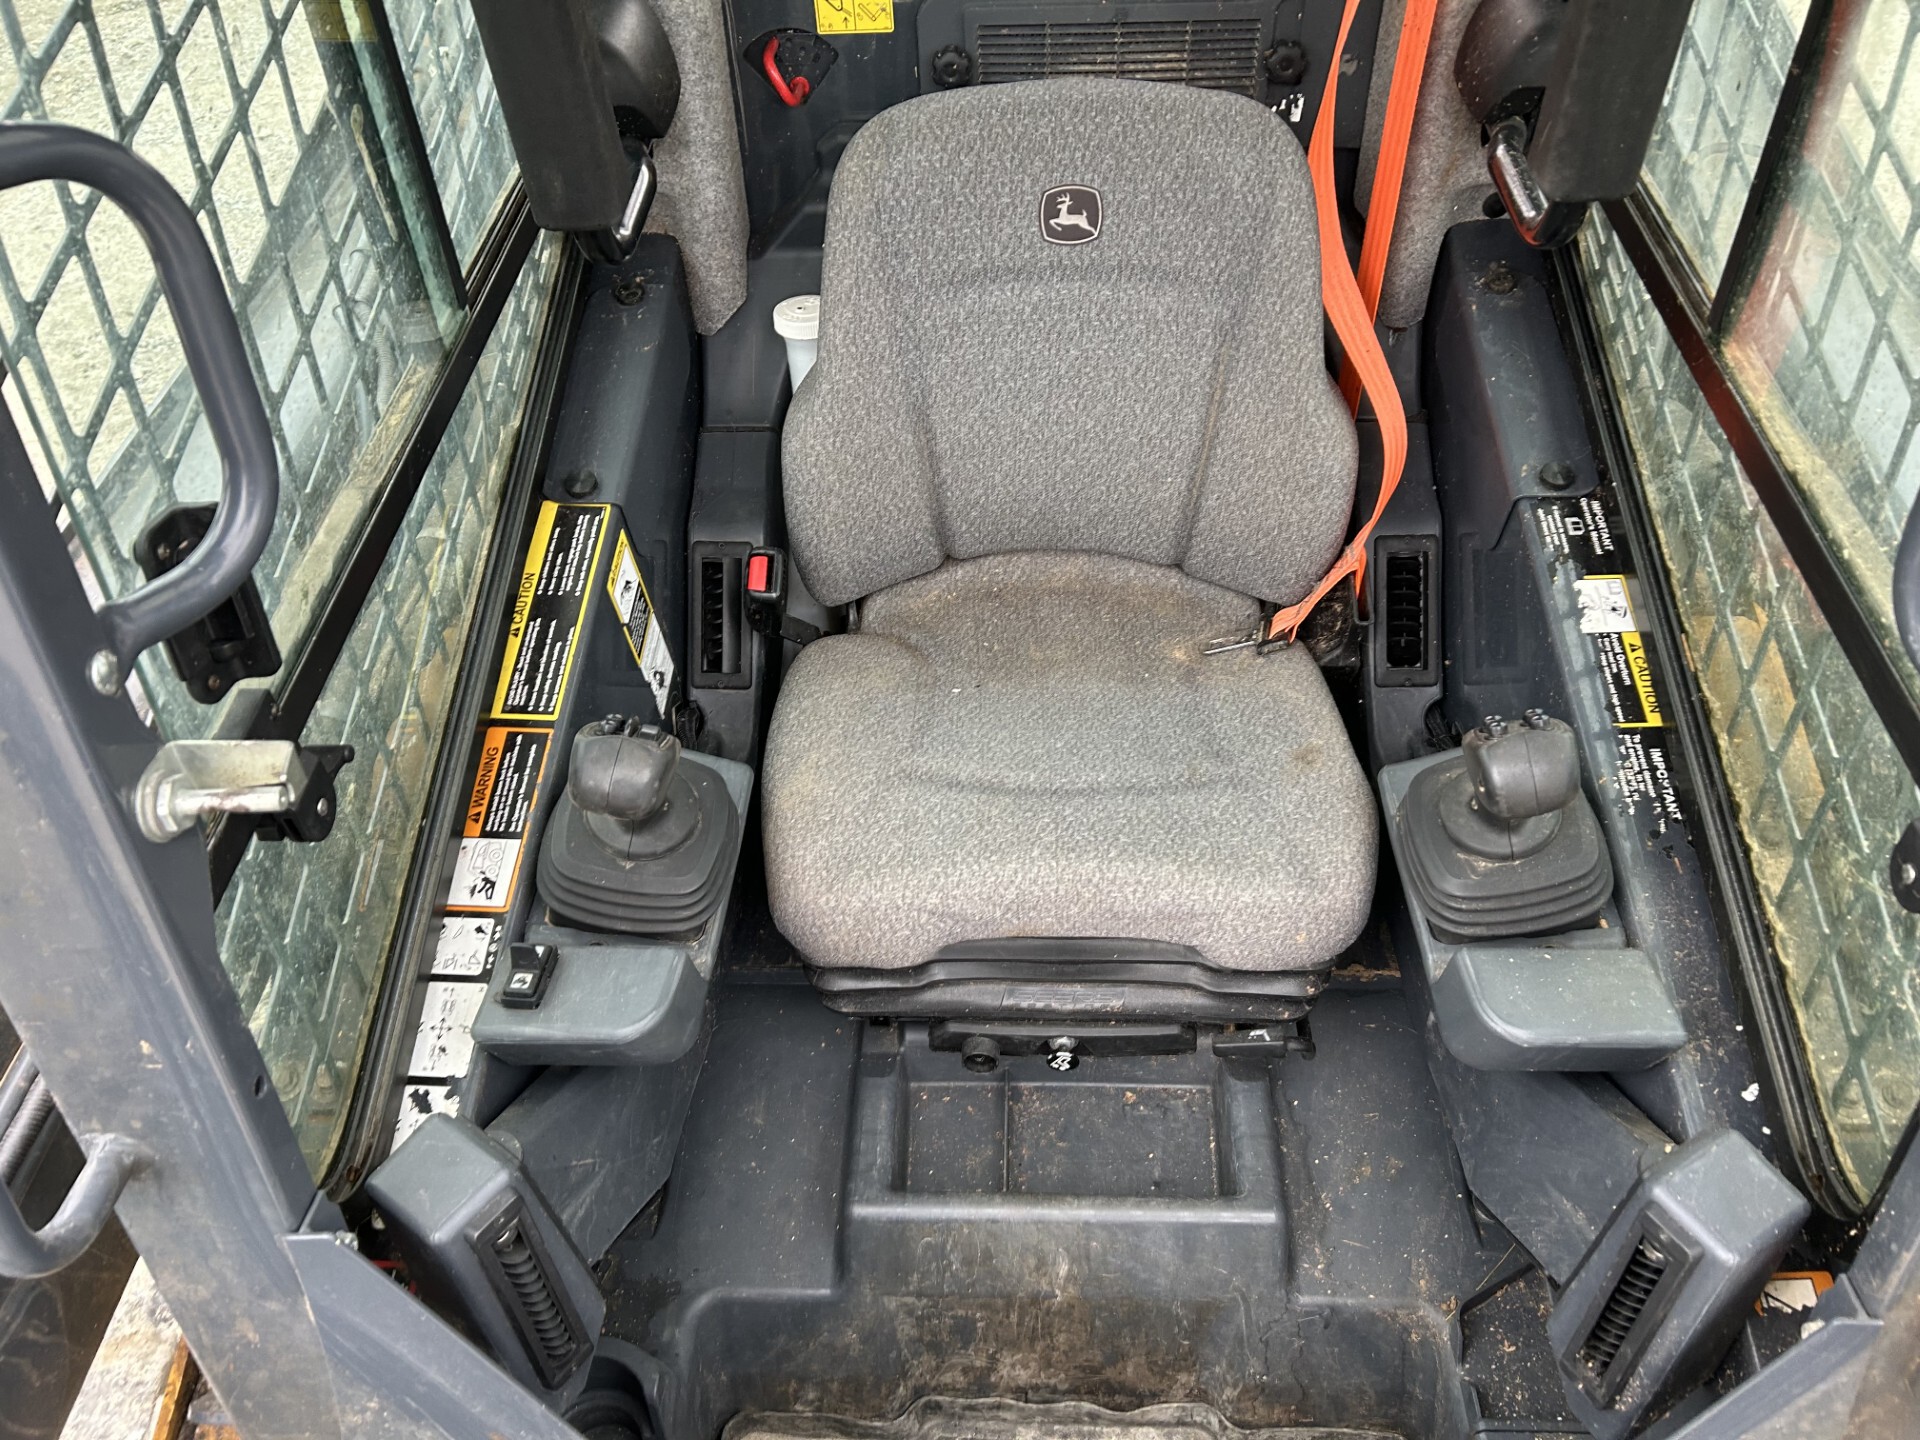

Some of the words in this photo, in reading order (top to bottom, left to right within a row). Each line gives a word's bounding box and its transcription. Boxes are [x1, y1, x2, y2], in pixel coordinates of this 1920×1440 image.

[1580, 498, 1595, 530] Operator's
[1590, 531, 1604, 554] Manual
[1590, 501, 1614, 550] IMPORTANT
[514, 573, 535, 624] CAUTION
[1609, 633, 1623, 653] Avoid
[1616, 654, 1631, 685] Overturn
[1634, 656, 1660, 714] CAUTION
[1623, 734, 1634, 747] and
[1632, 734, 1641, 743] To
[1634, 744, 1649, 769] prevent
[472, 747, 499, 809] WARNING
